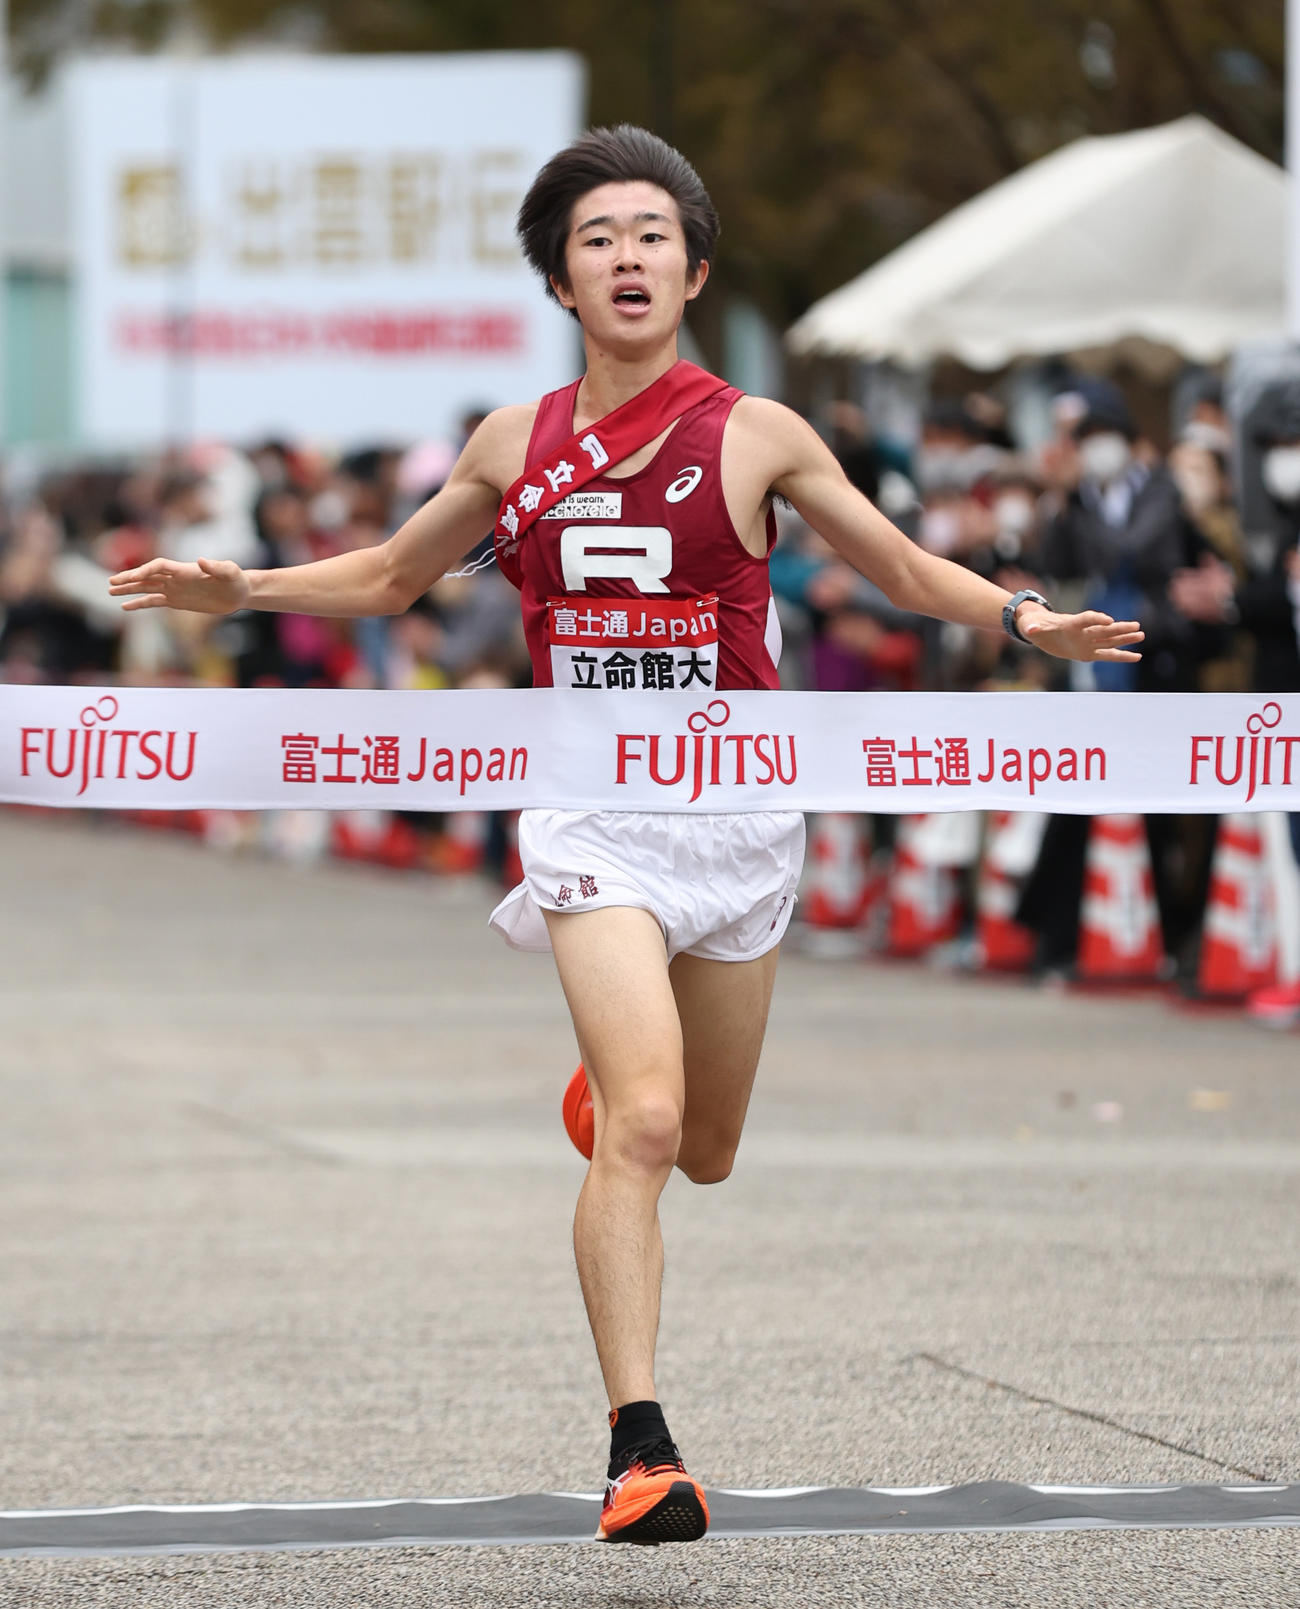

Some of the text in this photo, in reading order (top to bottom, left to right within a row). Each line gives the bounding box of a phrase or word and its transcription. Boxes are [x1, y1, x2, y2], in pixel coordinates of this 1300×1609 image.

[560, 525, 673, 593] R
[571, 651, 713, 691] 立命館大
[20, 696, 198, 795] FUJITSU
[615, 699, 798, 803] FUJITSU
